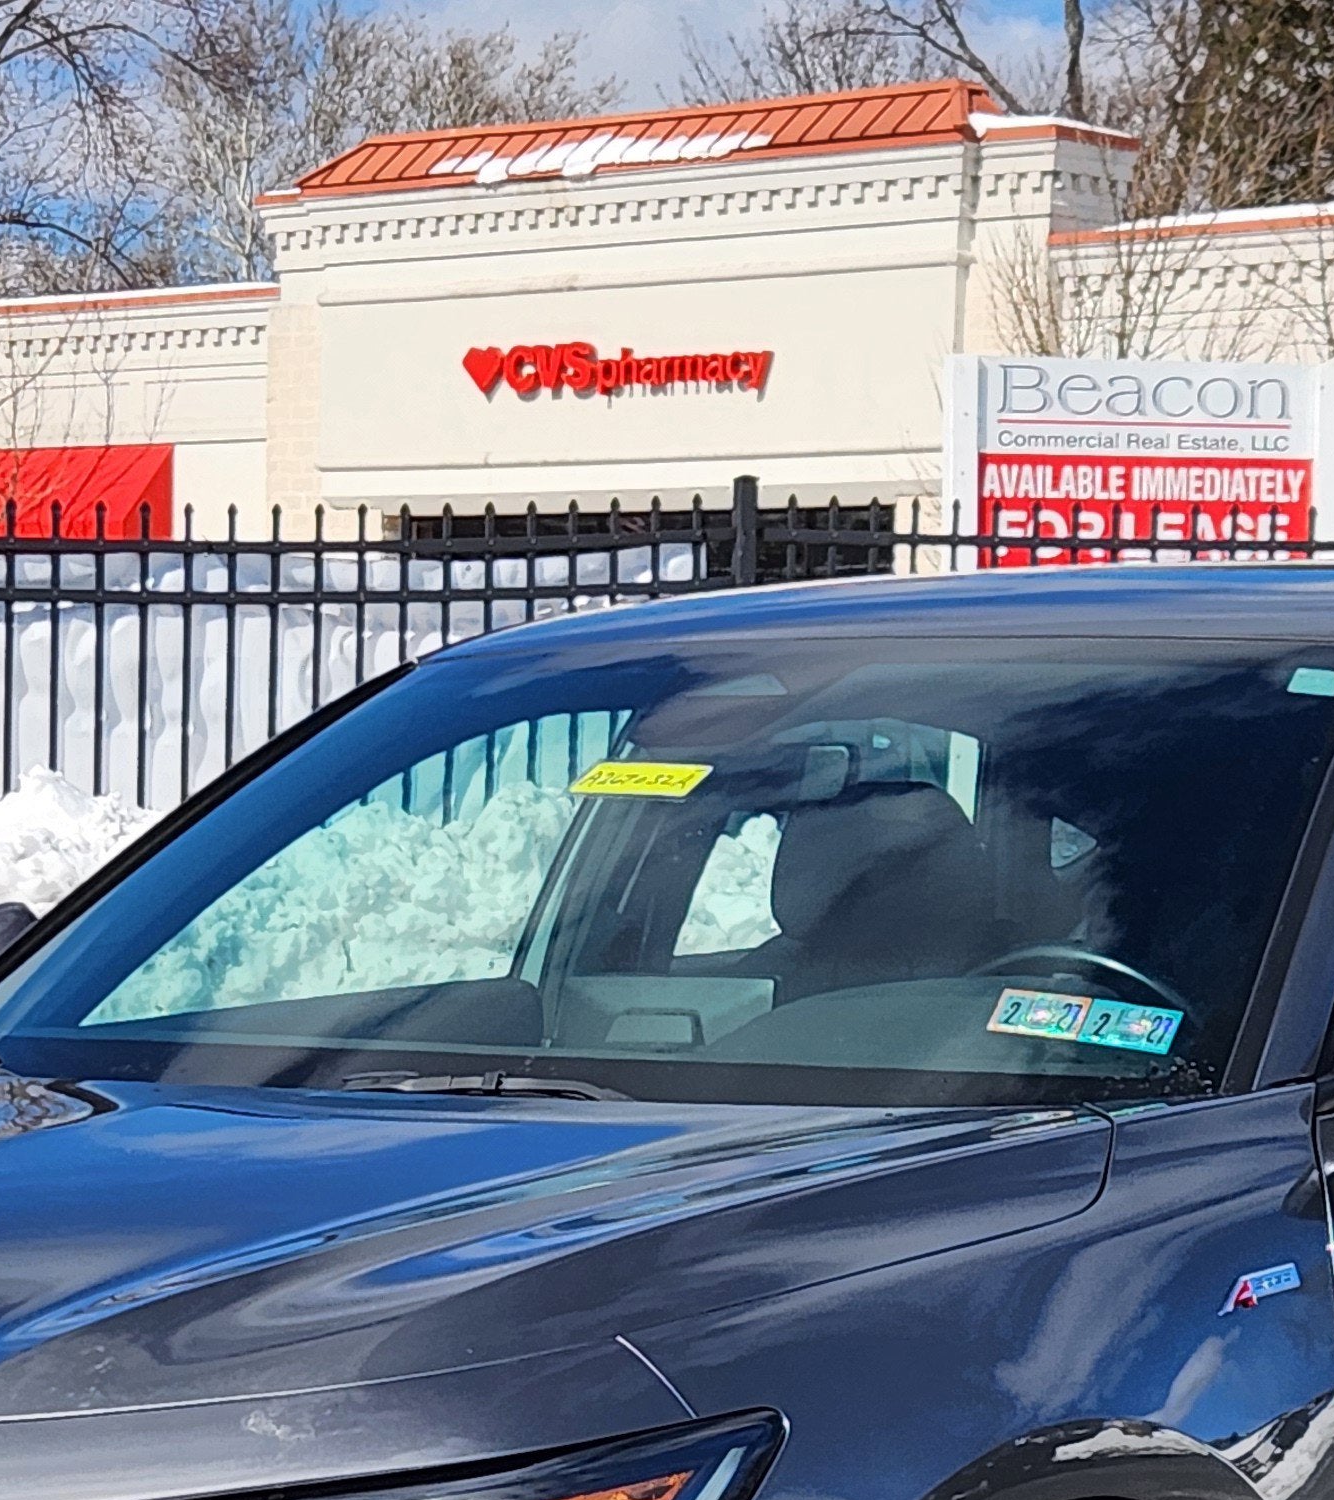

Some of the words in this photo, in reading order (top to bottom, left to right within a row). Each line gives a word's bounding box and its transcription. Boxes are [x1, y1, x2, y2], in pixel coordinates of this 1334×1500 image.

[504, 342, 598, 393] CVS
[596, 347, 770, 396] pharmacy
[997, 363, 1293, 420] Beacon
[998, 430, 1120, 450] Commercial
[1127, 433, 1170, 450] Real
[1177, 434, 1245, 452] Estate,
[1251, 435, 1289, 452] LLC
[983, 463, 1126, 500] AVAILABLE
[1131, 466, 1307, 504] IMMEDIATELY
[1002, 1001, 1022, 1025] 2
[1092, 1012, 1112, 1037] 2
[1146, 1015, 1174, 1046] 27
